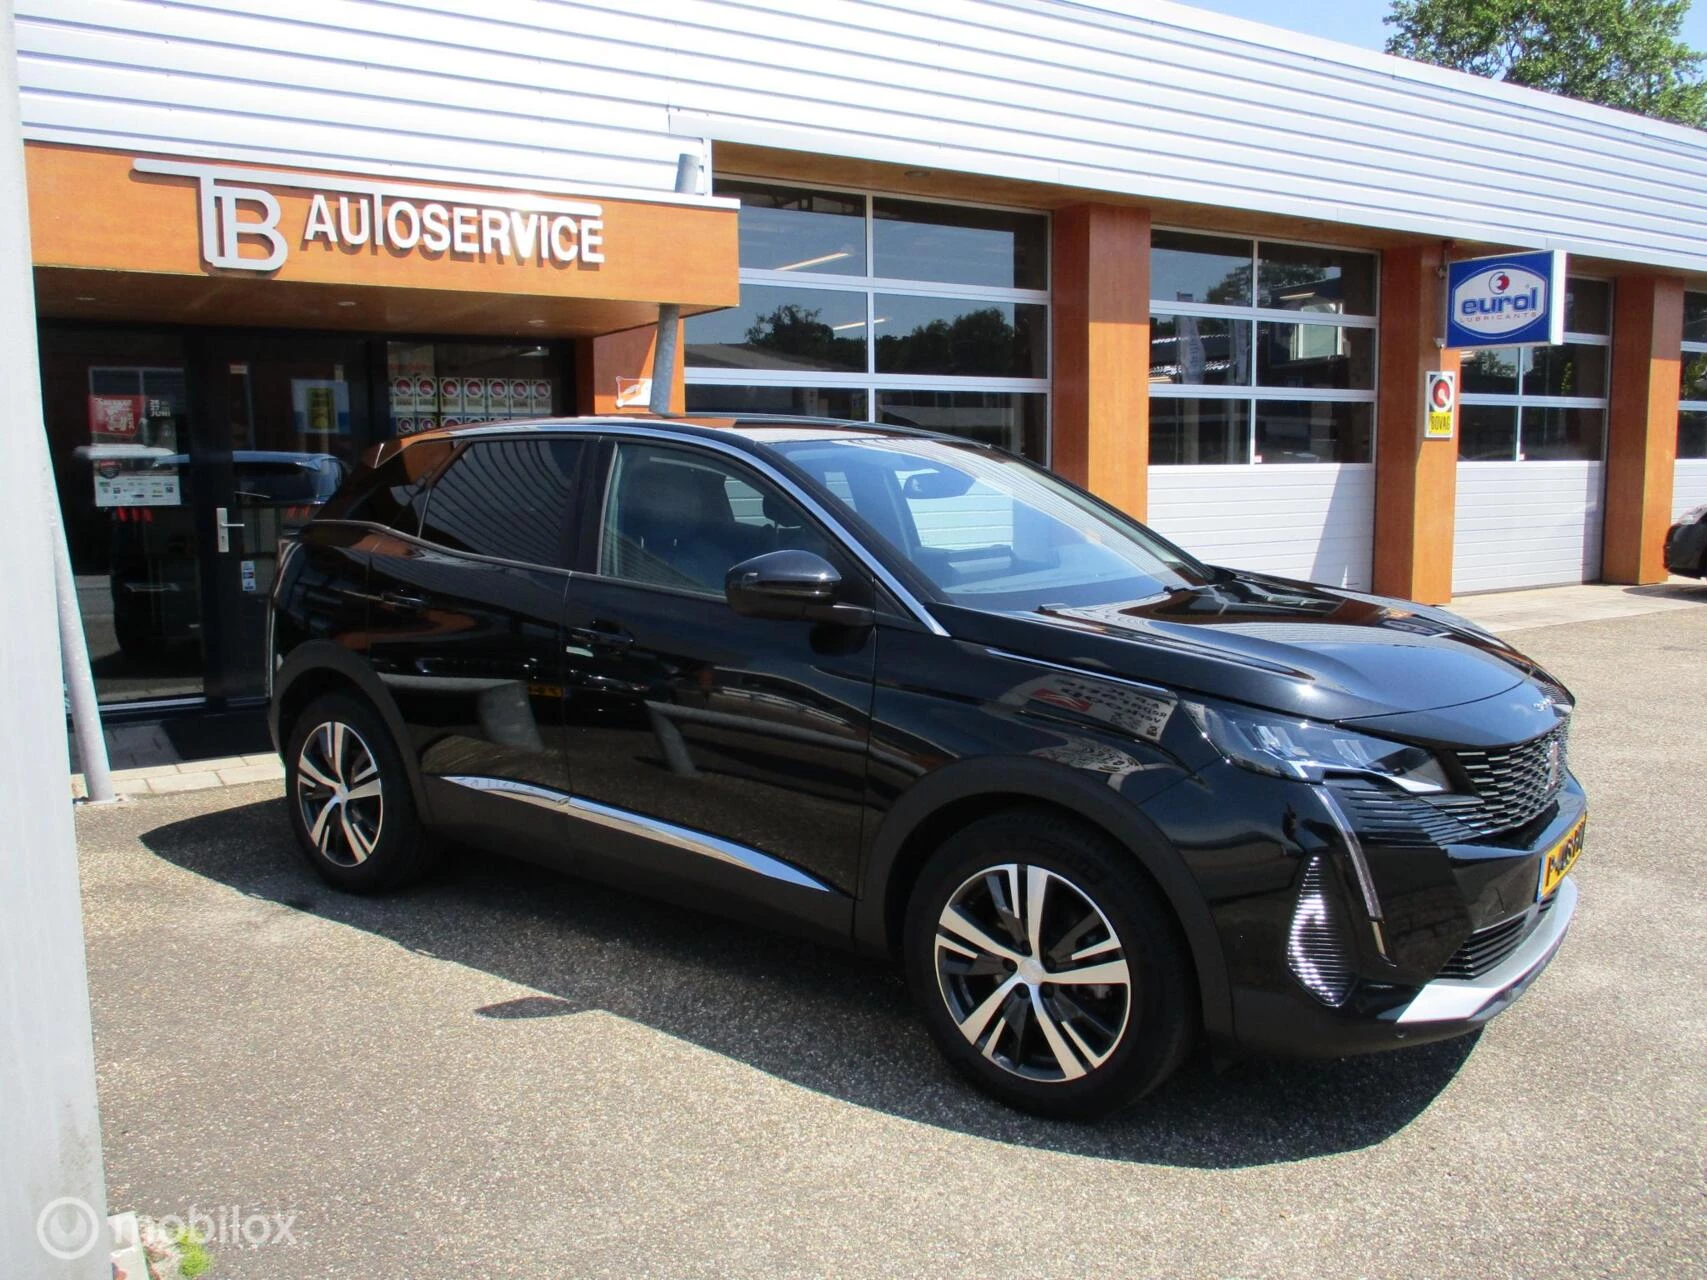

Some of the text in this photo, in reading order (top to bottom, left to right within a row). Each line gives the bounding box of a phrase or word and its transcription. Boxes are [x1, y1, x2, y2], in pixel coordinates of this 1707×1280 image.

[133, 158, 604, 271] TB AUTOSERVICE
[1461, 286, 1538, 316] eurol
[1459, 312, 1537, 323] LUBRICANTS
